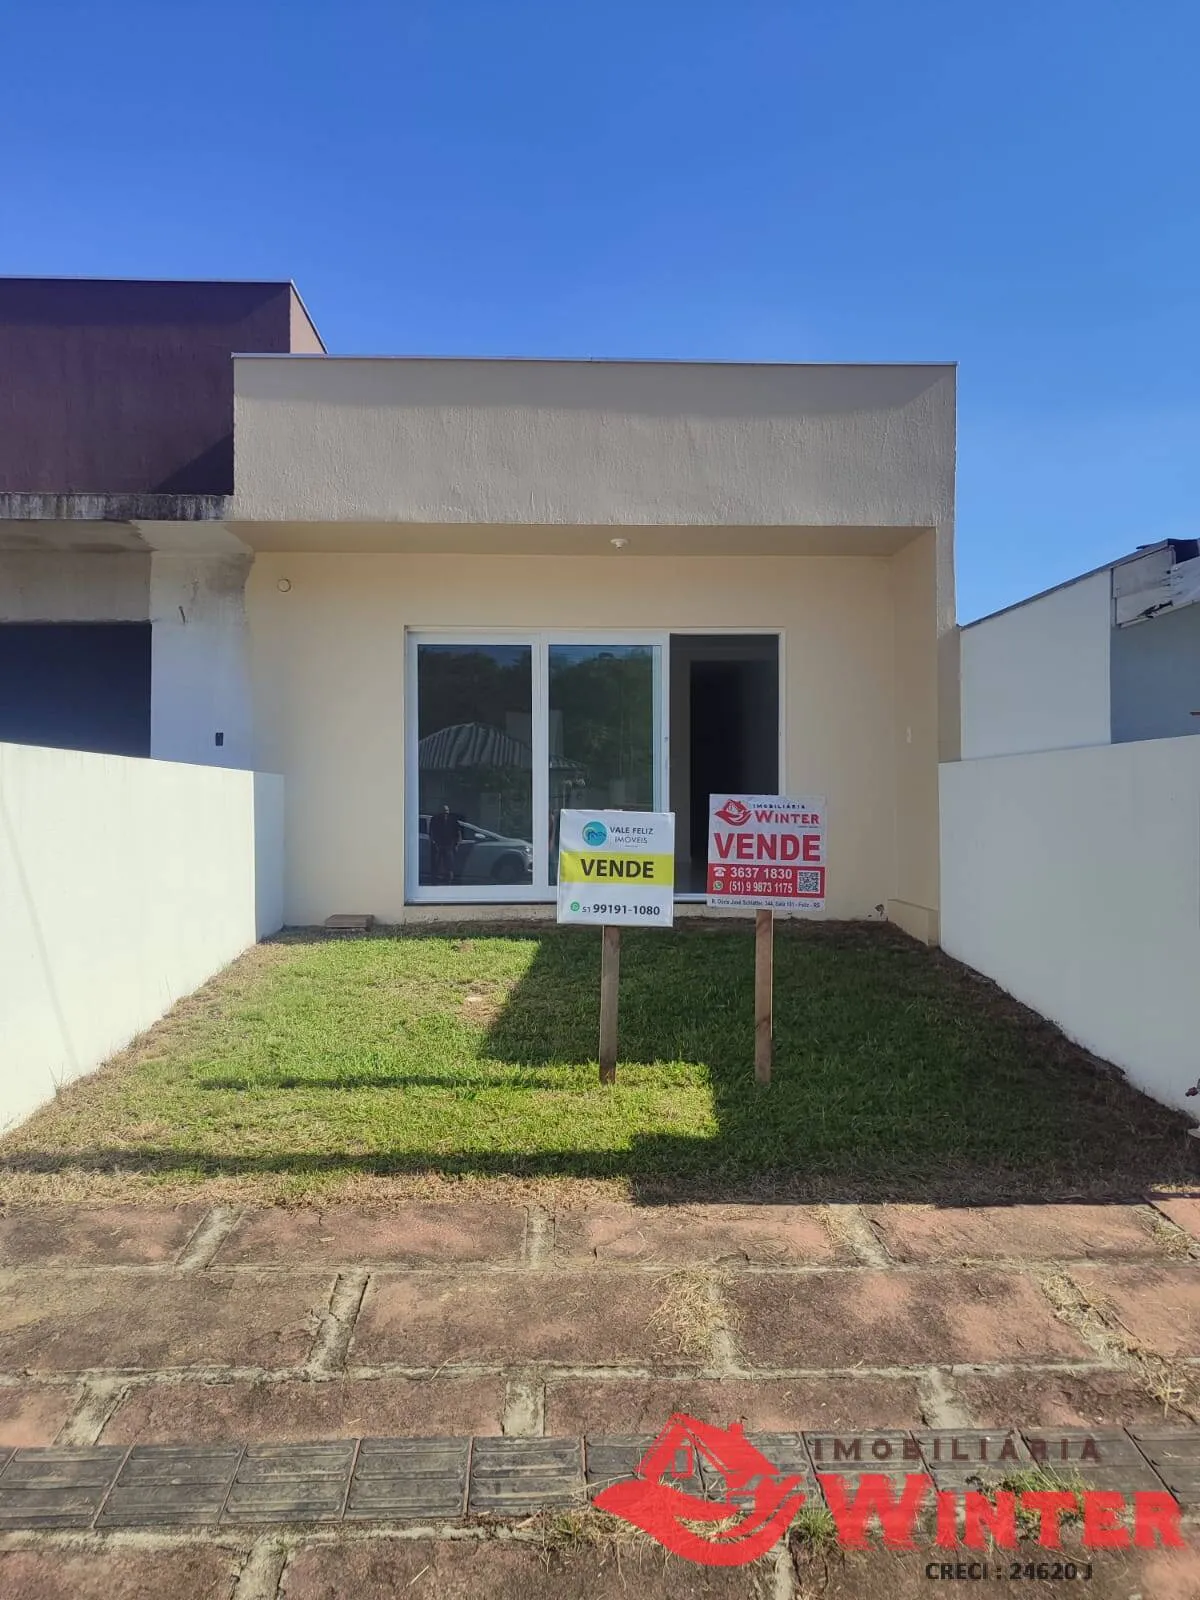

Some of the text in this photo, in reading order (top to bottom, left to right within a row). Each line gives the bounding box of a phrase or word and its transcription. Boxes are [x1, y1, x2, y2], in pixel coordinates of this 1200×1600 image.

[609, 826, 654, 835] VALE FELIZ
[713, 832, 821, 861] VENDE
[580, 858, 654, 879] VENDE
[730, 867, 793, 880] 3637 1830
[729, 881, 793, 894] (51) 9 9873 1175
[593, 904, 660, 916] 99191-1080
